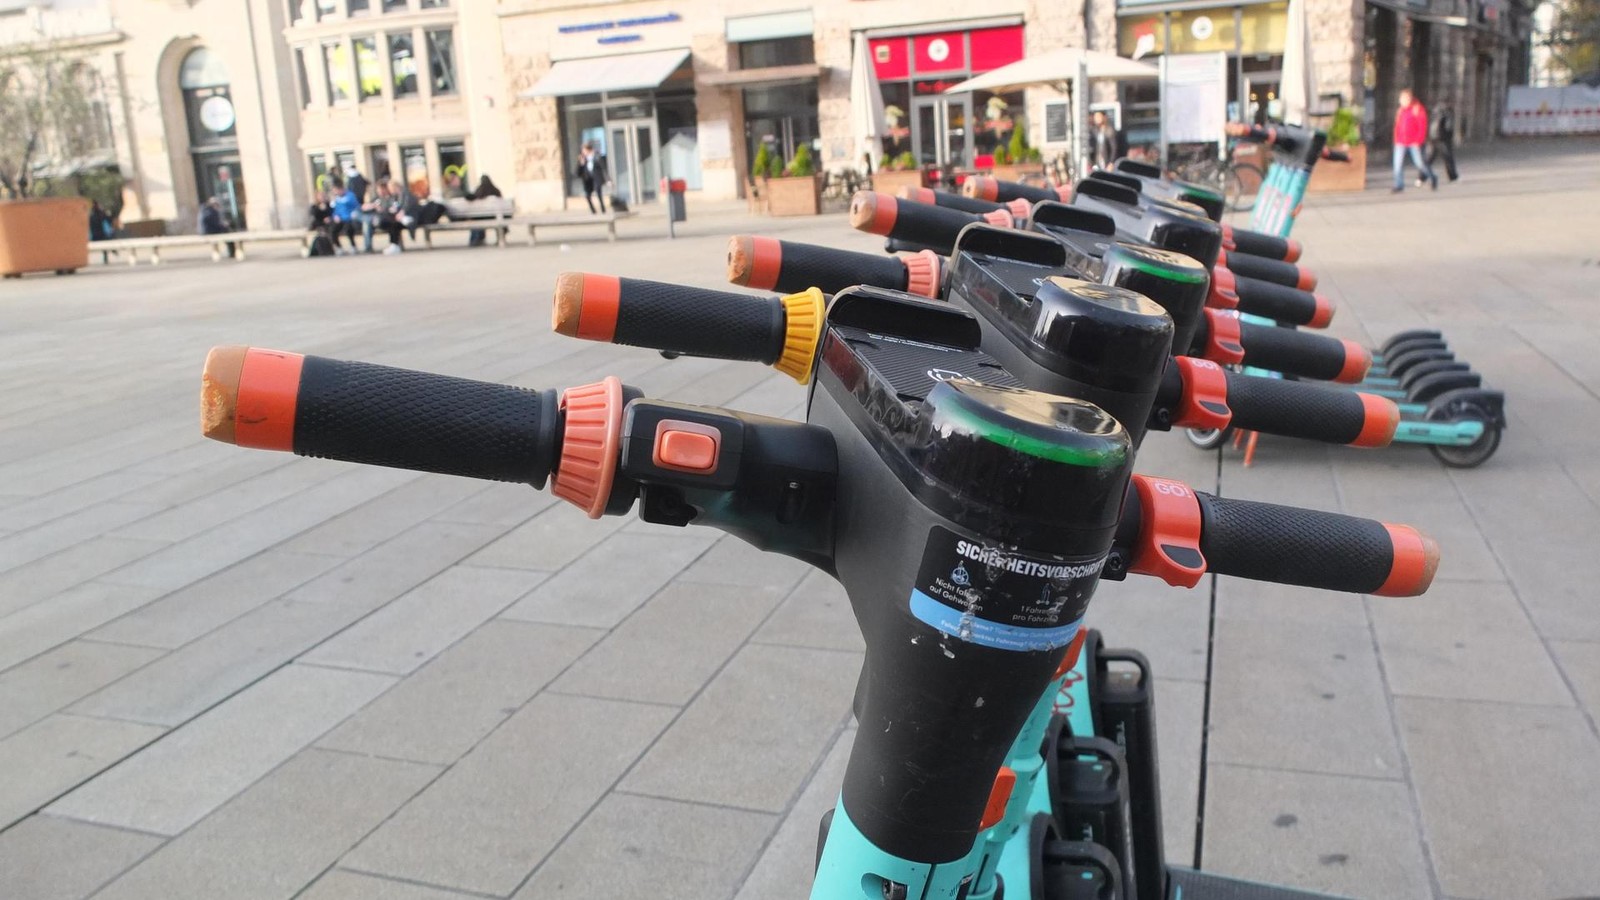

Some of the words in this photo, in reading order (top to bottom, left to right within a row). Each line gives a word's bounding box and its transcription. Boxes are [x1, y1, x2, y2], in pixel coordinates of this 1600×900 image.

[1153, 482, 1193, 499] GO!
[929, 585, 943, 596] auf
[935, 577, 956, 592] Nicht
[1012, 614, 1027, 622] pro
